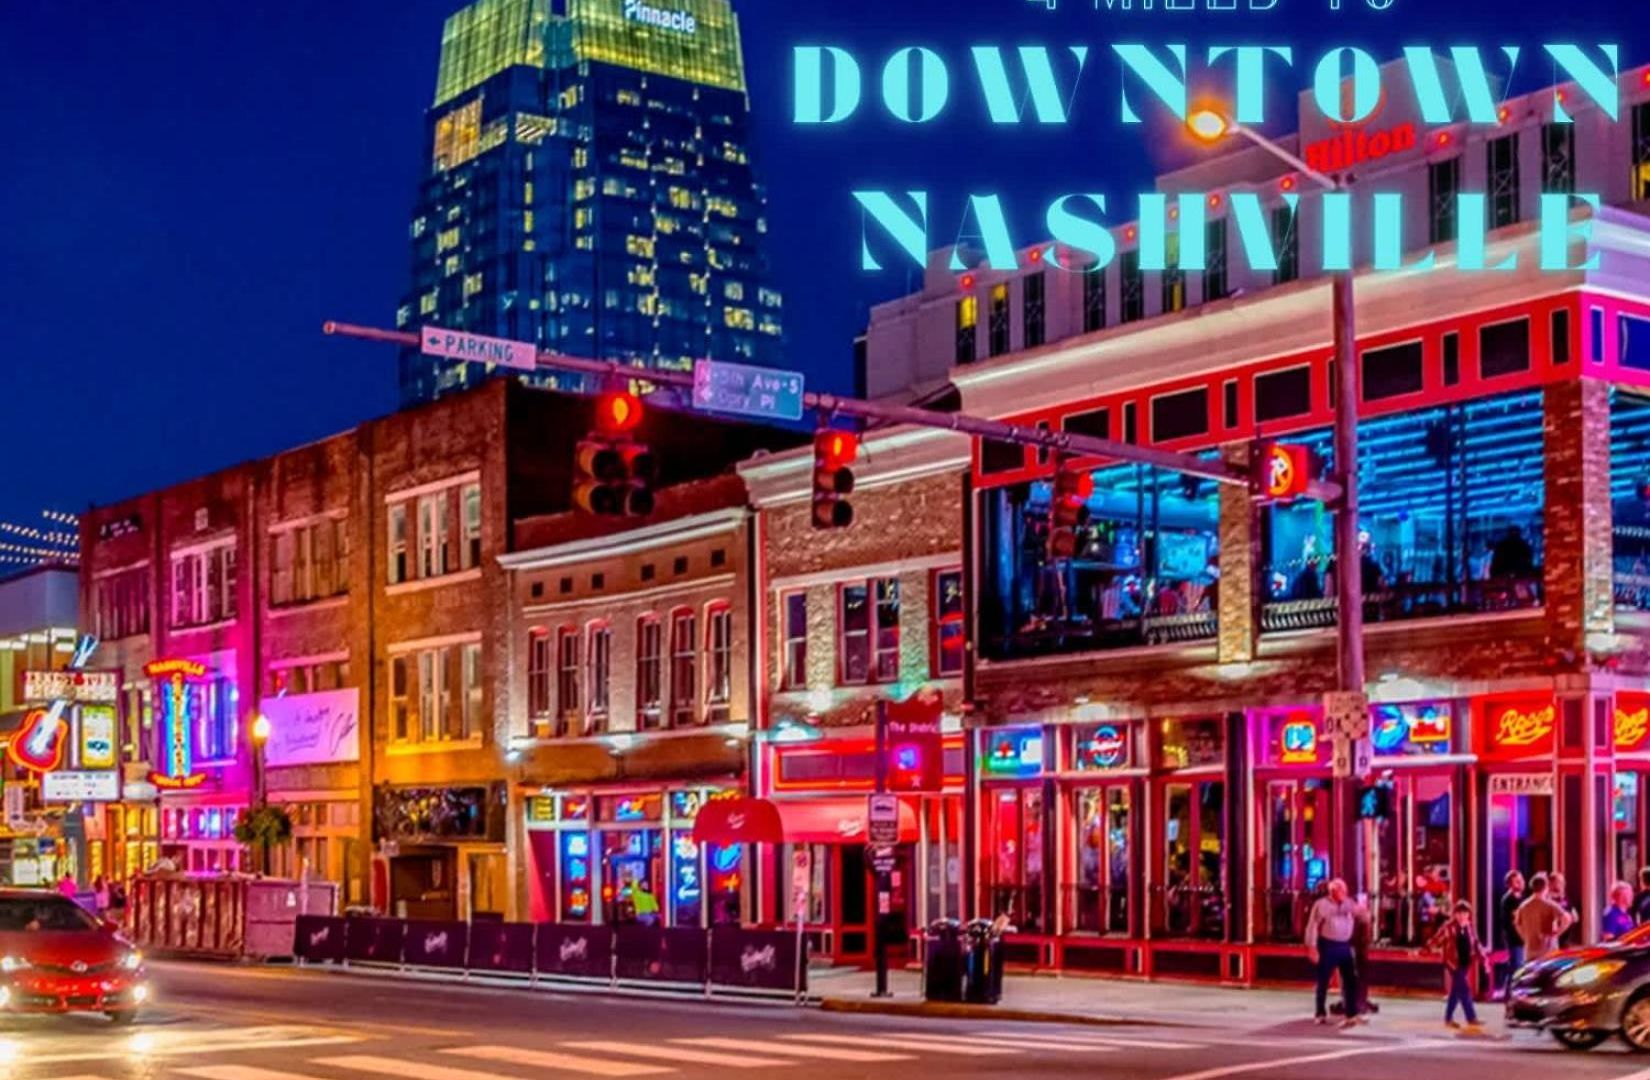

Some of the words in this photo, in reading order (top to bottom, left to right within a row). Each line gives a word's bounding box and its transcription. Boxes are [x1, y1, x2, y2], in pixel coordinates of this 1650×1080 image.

[625, 0, 695, 33] Pinnacle
[1306, 123, 1415, 172] Hilton
[445, 334, 513, 362] PARKING
